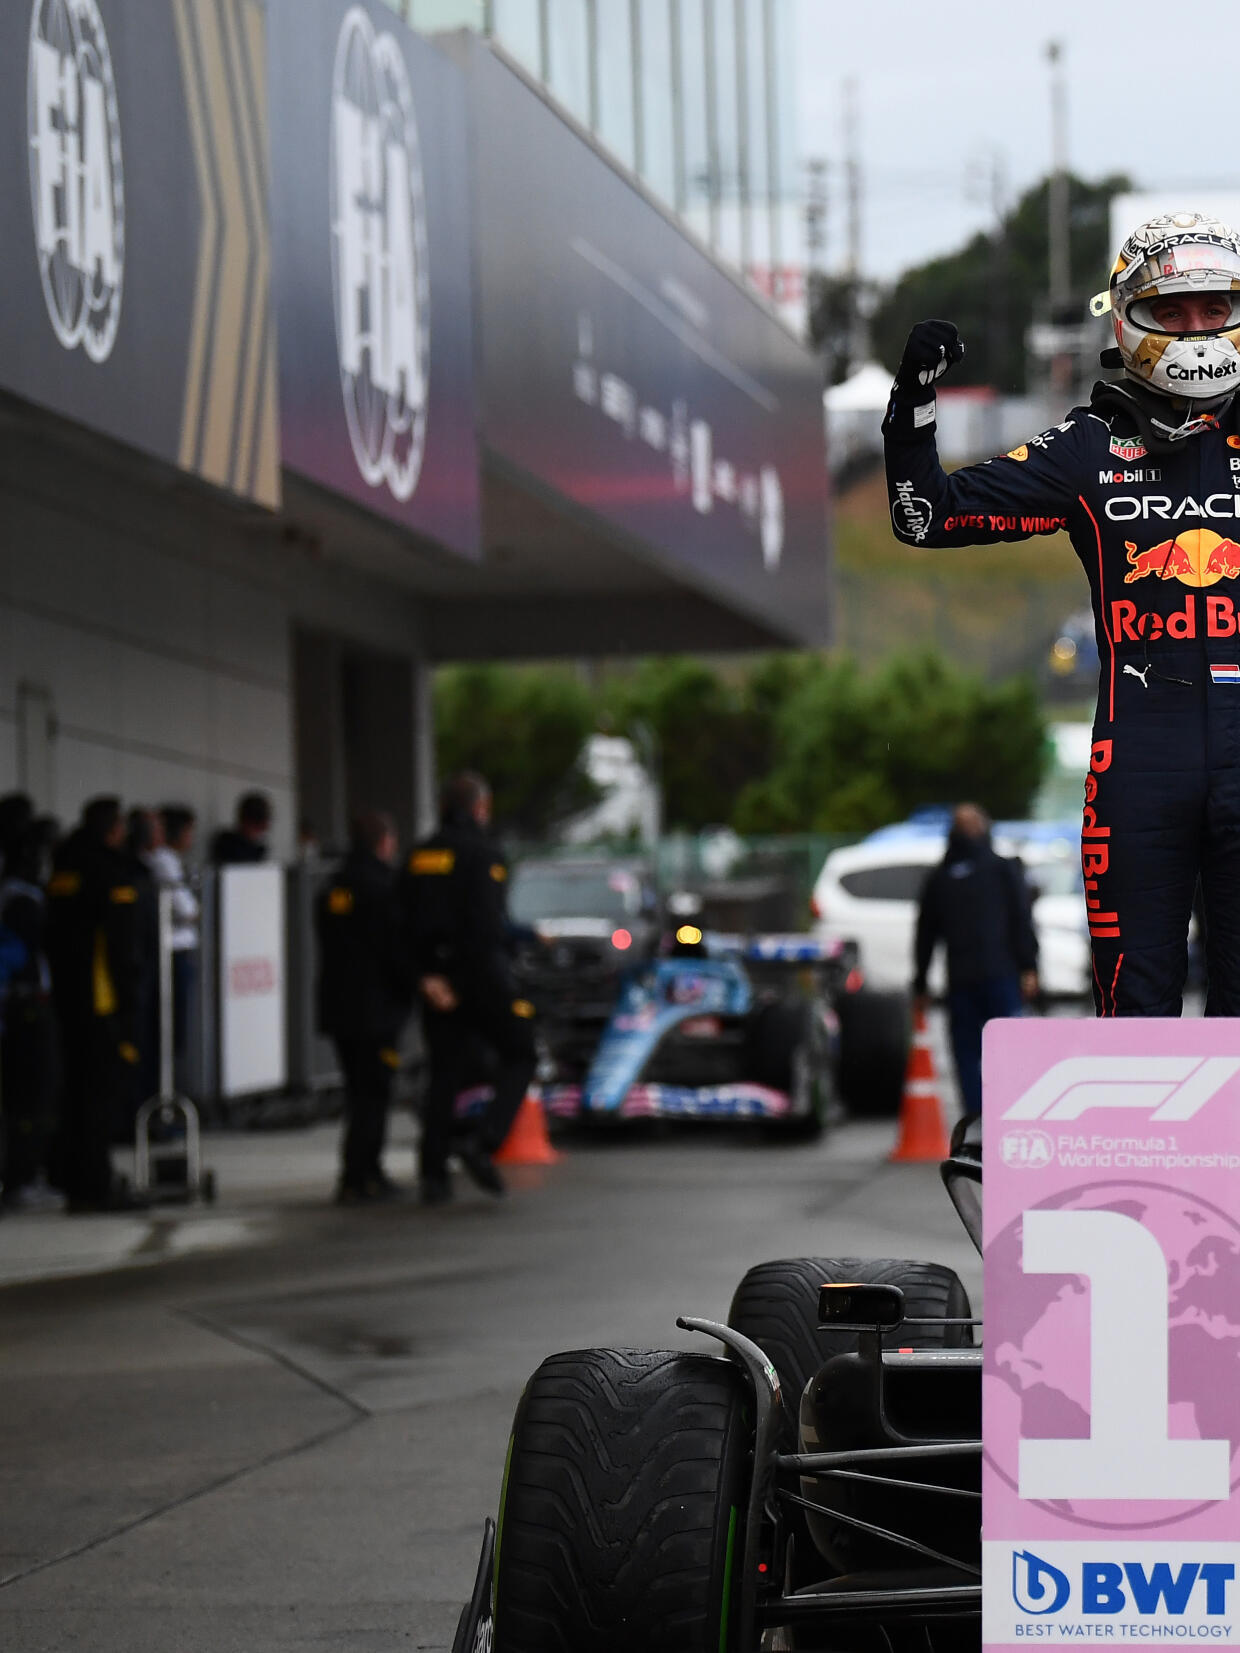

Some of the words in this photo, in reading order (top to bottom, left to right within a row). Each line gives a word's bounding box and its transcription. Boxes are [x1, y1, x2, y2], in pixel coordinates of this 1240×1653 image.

[1146, 233, 1237, 256] ORACLE
[1166, 361, 1237, 381] CarNext
[1099, 469, 1144, 485] Mobil
[944, 515, 985, 531] GIVES
[988, 515, 1017, 531] YOU
[1111, 594, 1196, 643] Red
[1058, 1136, 1085, 1151] FIA
[1091, 1136, 1165, 1151] Formula
[1168, 1136, 1178, 1151] 1
[1058, 1153, 1111, 1168] World
[1018, 1209, 1230, 1500] 1
[1082, 1562, 1236, 1615] BWT
[1015, 1624, 1052, 1637] BEST
[1058, 1624, 1115, 1637] WATER
[1119, 1624, 1233, 1638] TECHNOLOGY
